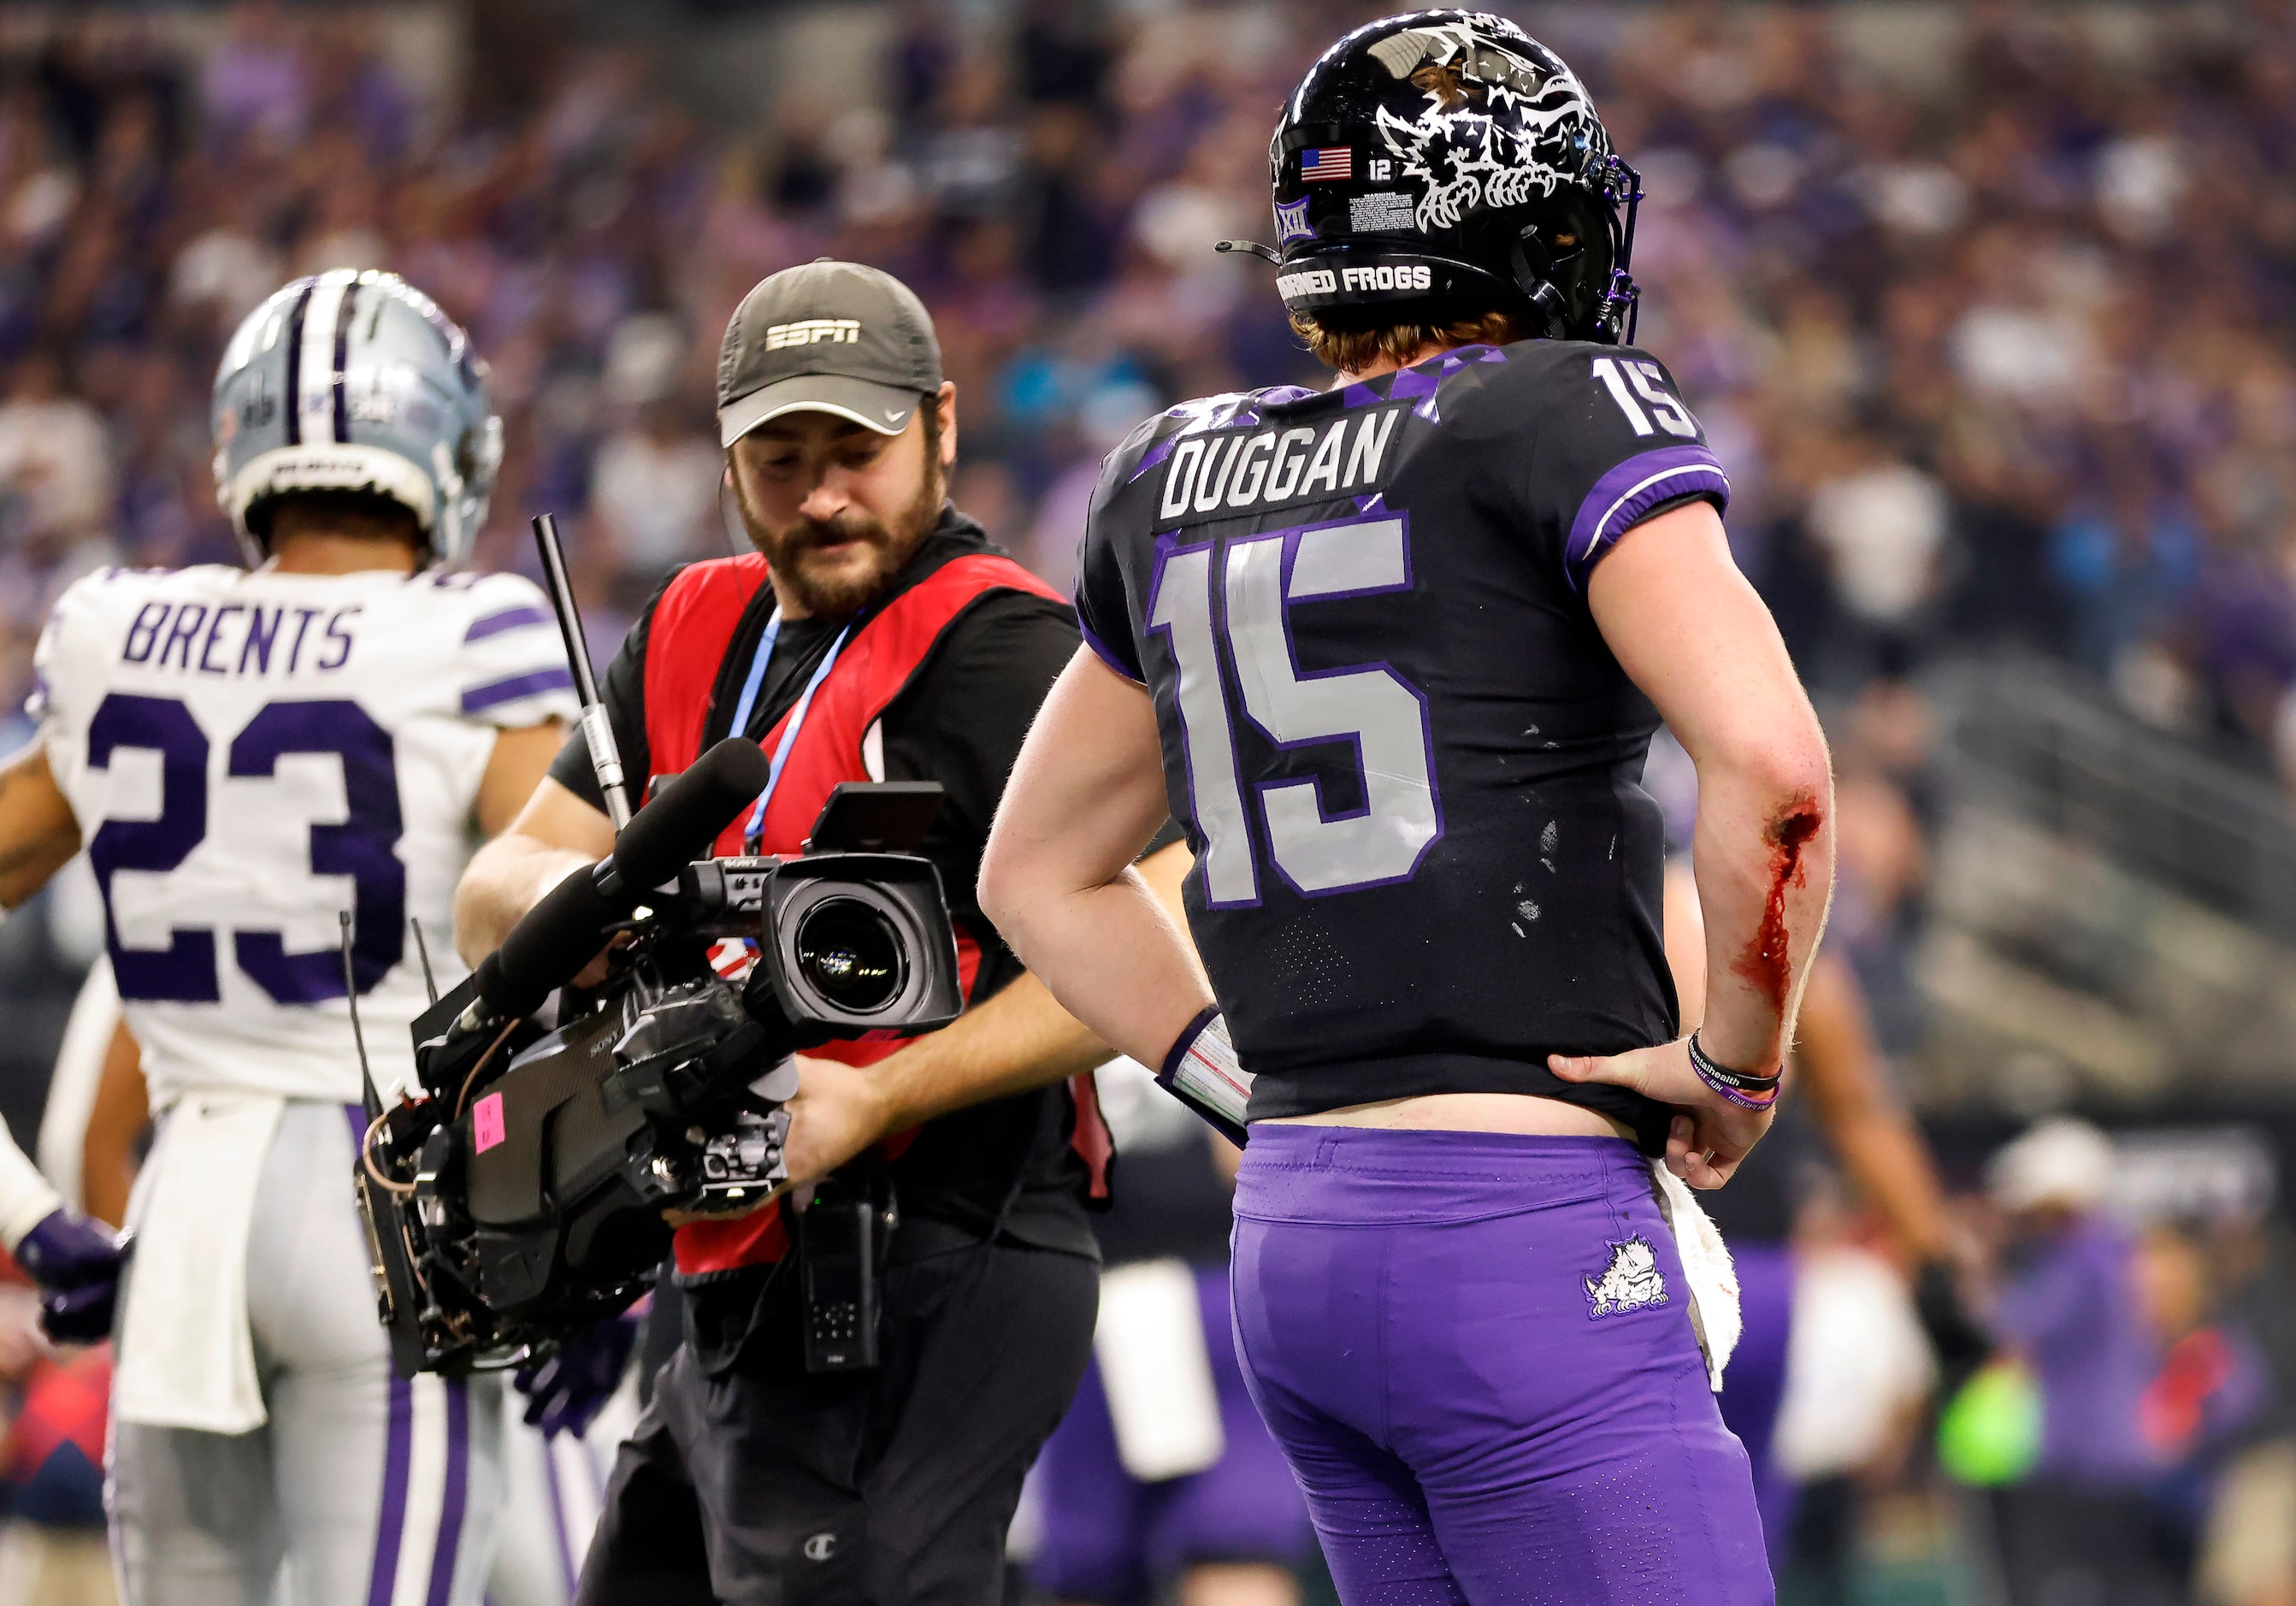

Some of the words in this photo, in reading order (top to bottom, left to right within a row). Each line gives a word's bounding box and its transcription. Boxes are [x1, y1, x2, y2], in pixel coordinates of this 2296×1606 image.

[1368, 159, 1391, 181] 12
[1341, 265, 1431, 292] FROGS
[764, 319, 861, 352] ESPN
[1591, 356, 1698, 440] 15
[1159, 408, 1400, 520] DUGGAN
[122, 602, 363, 677] BRENTS
[1144, 510, 1445, 911] 15
[87, 693, 406, 1006] 23
